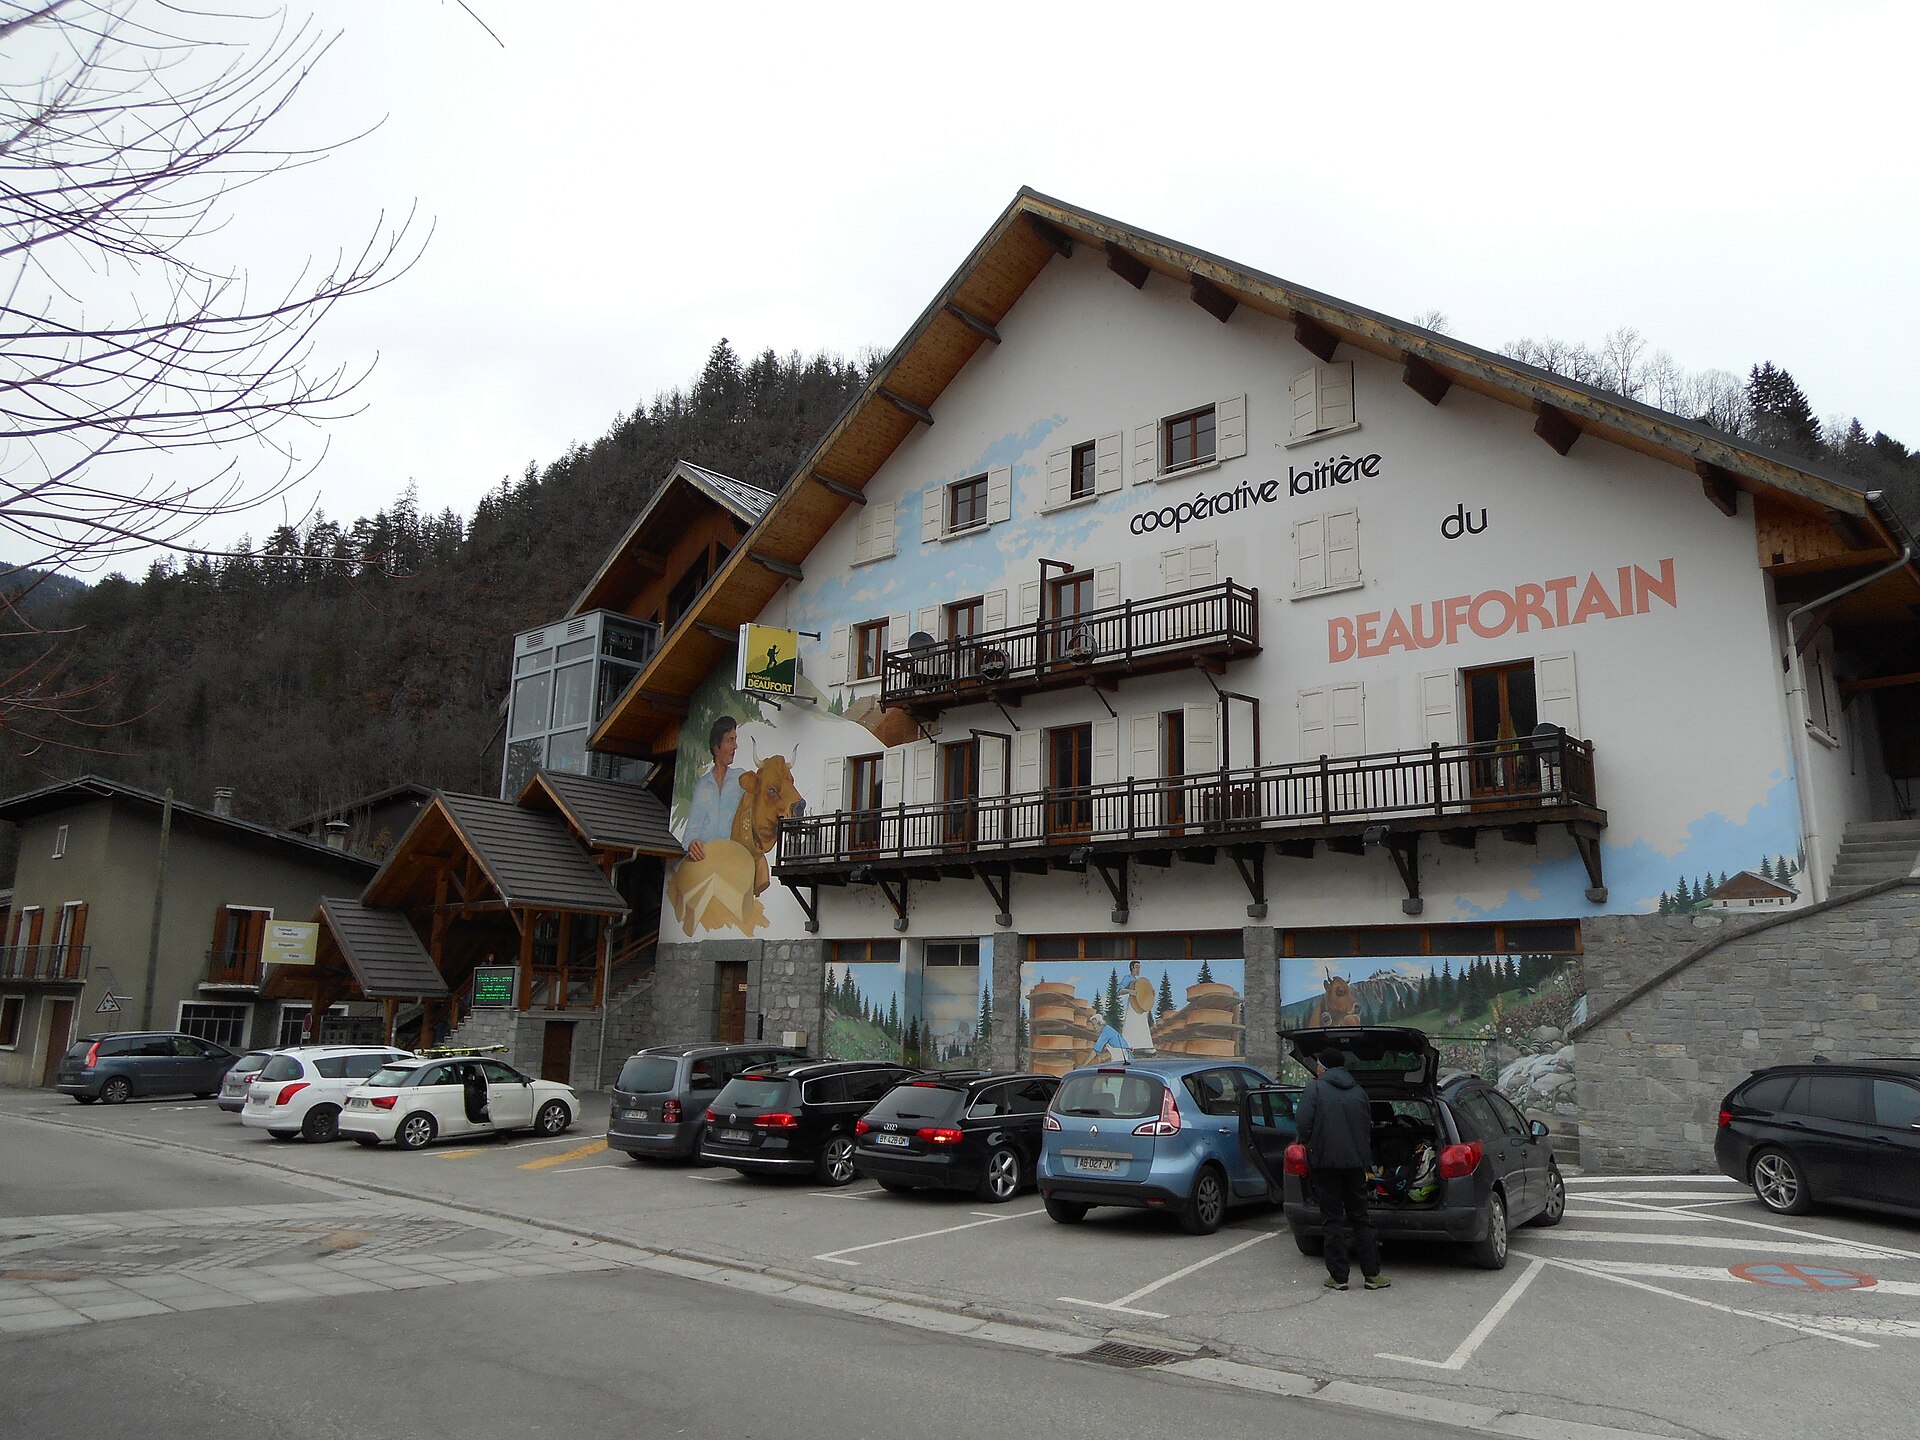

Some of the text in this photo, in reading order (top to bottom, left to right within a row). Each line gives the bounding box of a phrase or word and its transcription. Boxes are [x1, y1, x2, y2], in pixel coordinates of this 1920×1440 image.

[1129, 453, 1382, 535] coopérative laitière
[1440, 503, 1489, 540] du
[1327, 558, 1678, 663] BEAUFORTAIN
[747, 679, 793, 692] BEAUFORT
